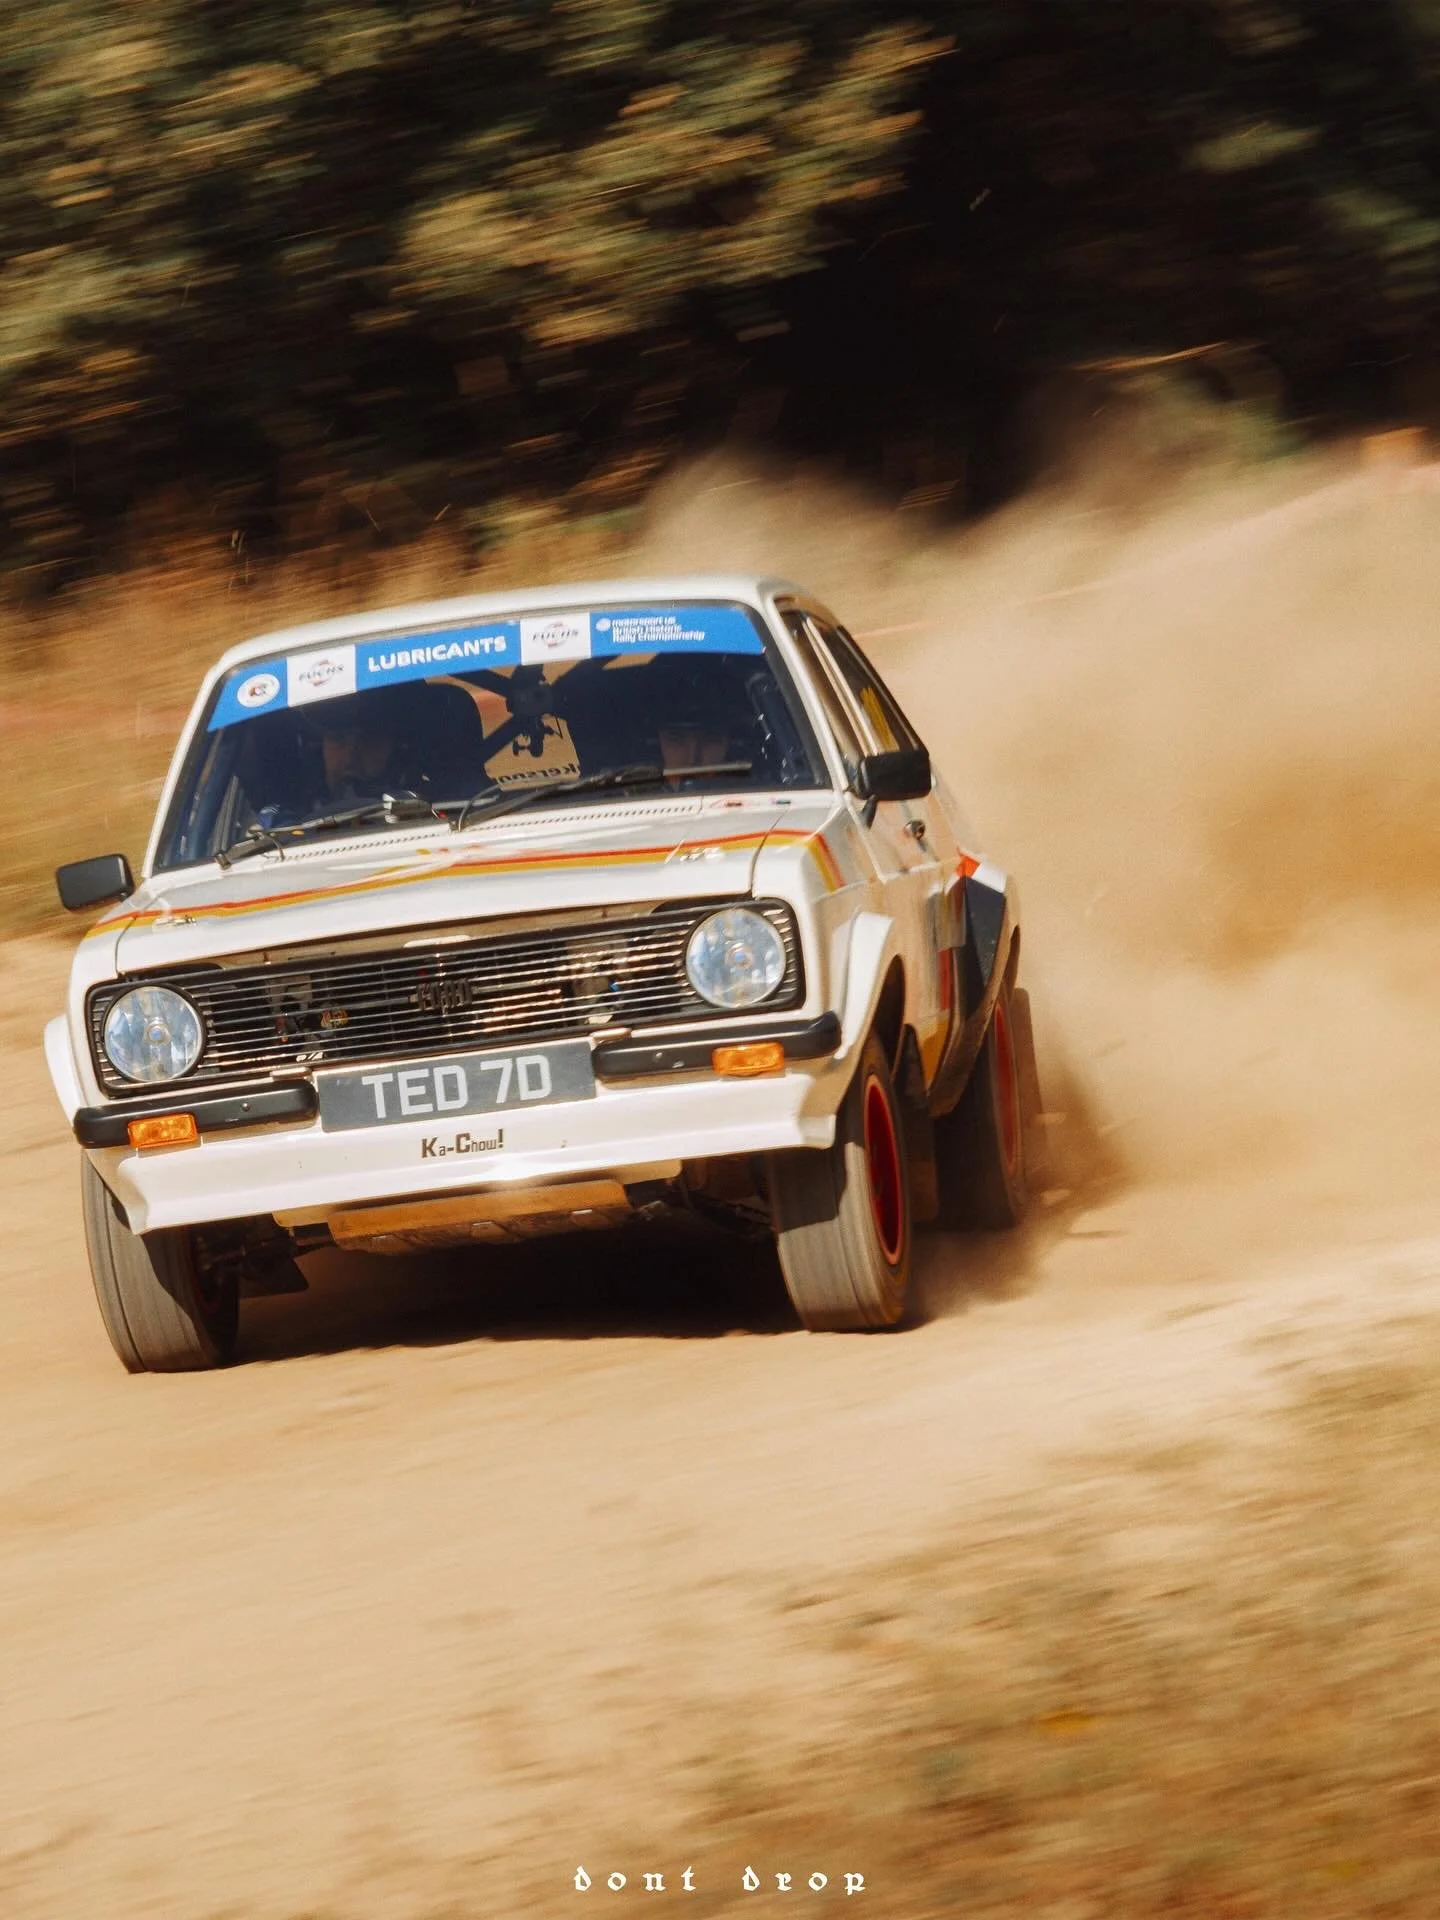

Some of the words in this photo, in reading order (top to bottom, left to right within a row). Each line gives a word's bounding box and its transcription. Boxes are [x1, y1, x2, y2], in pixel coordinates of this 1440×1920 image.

[368, 635, 507, 673] LUBRICANTS
[612, 631, 637, 644] Rally
[361, 1064, 469, 1119] TED
[480, 1054, 552, 1104] 7D
[421, 1128, 505, 1158] Ka-Chow!
